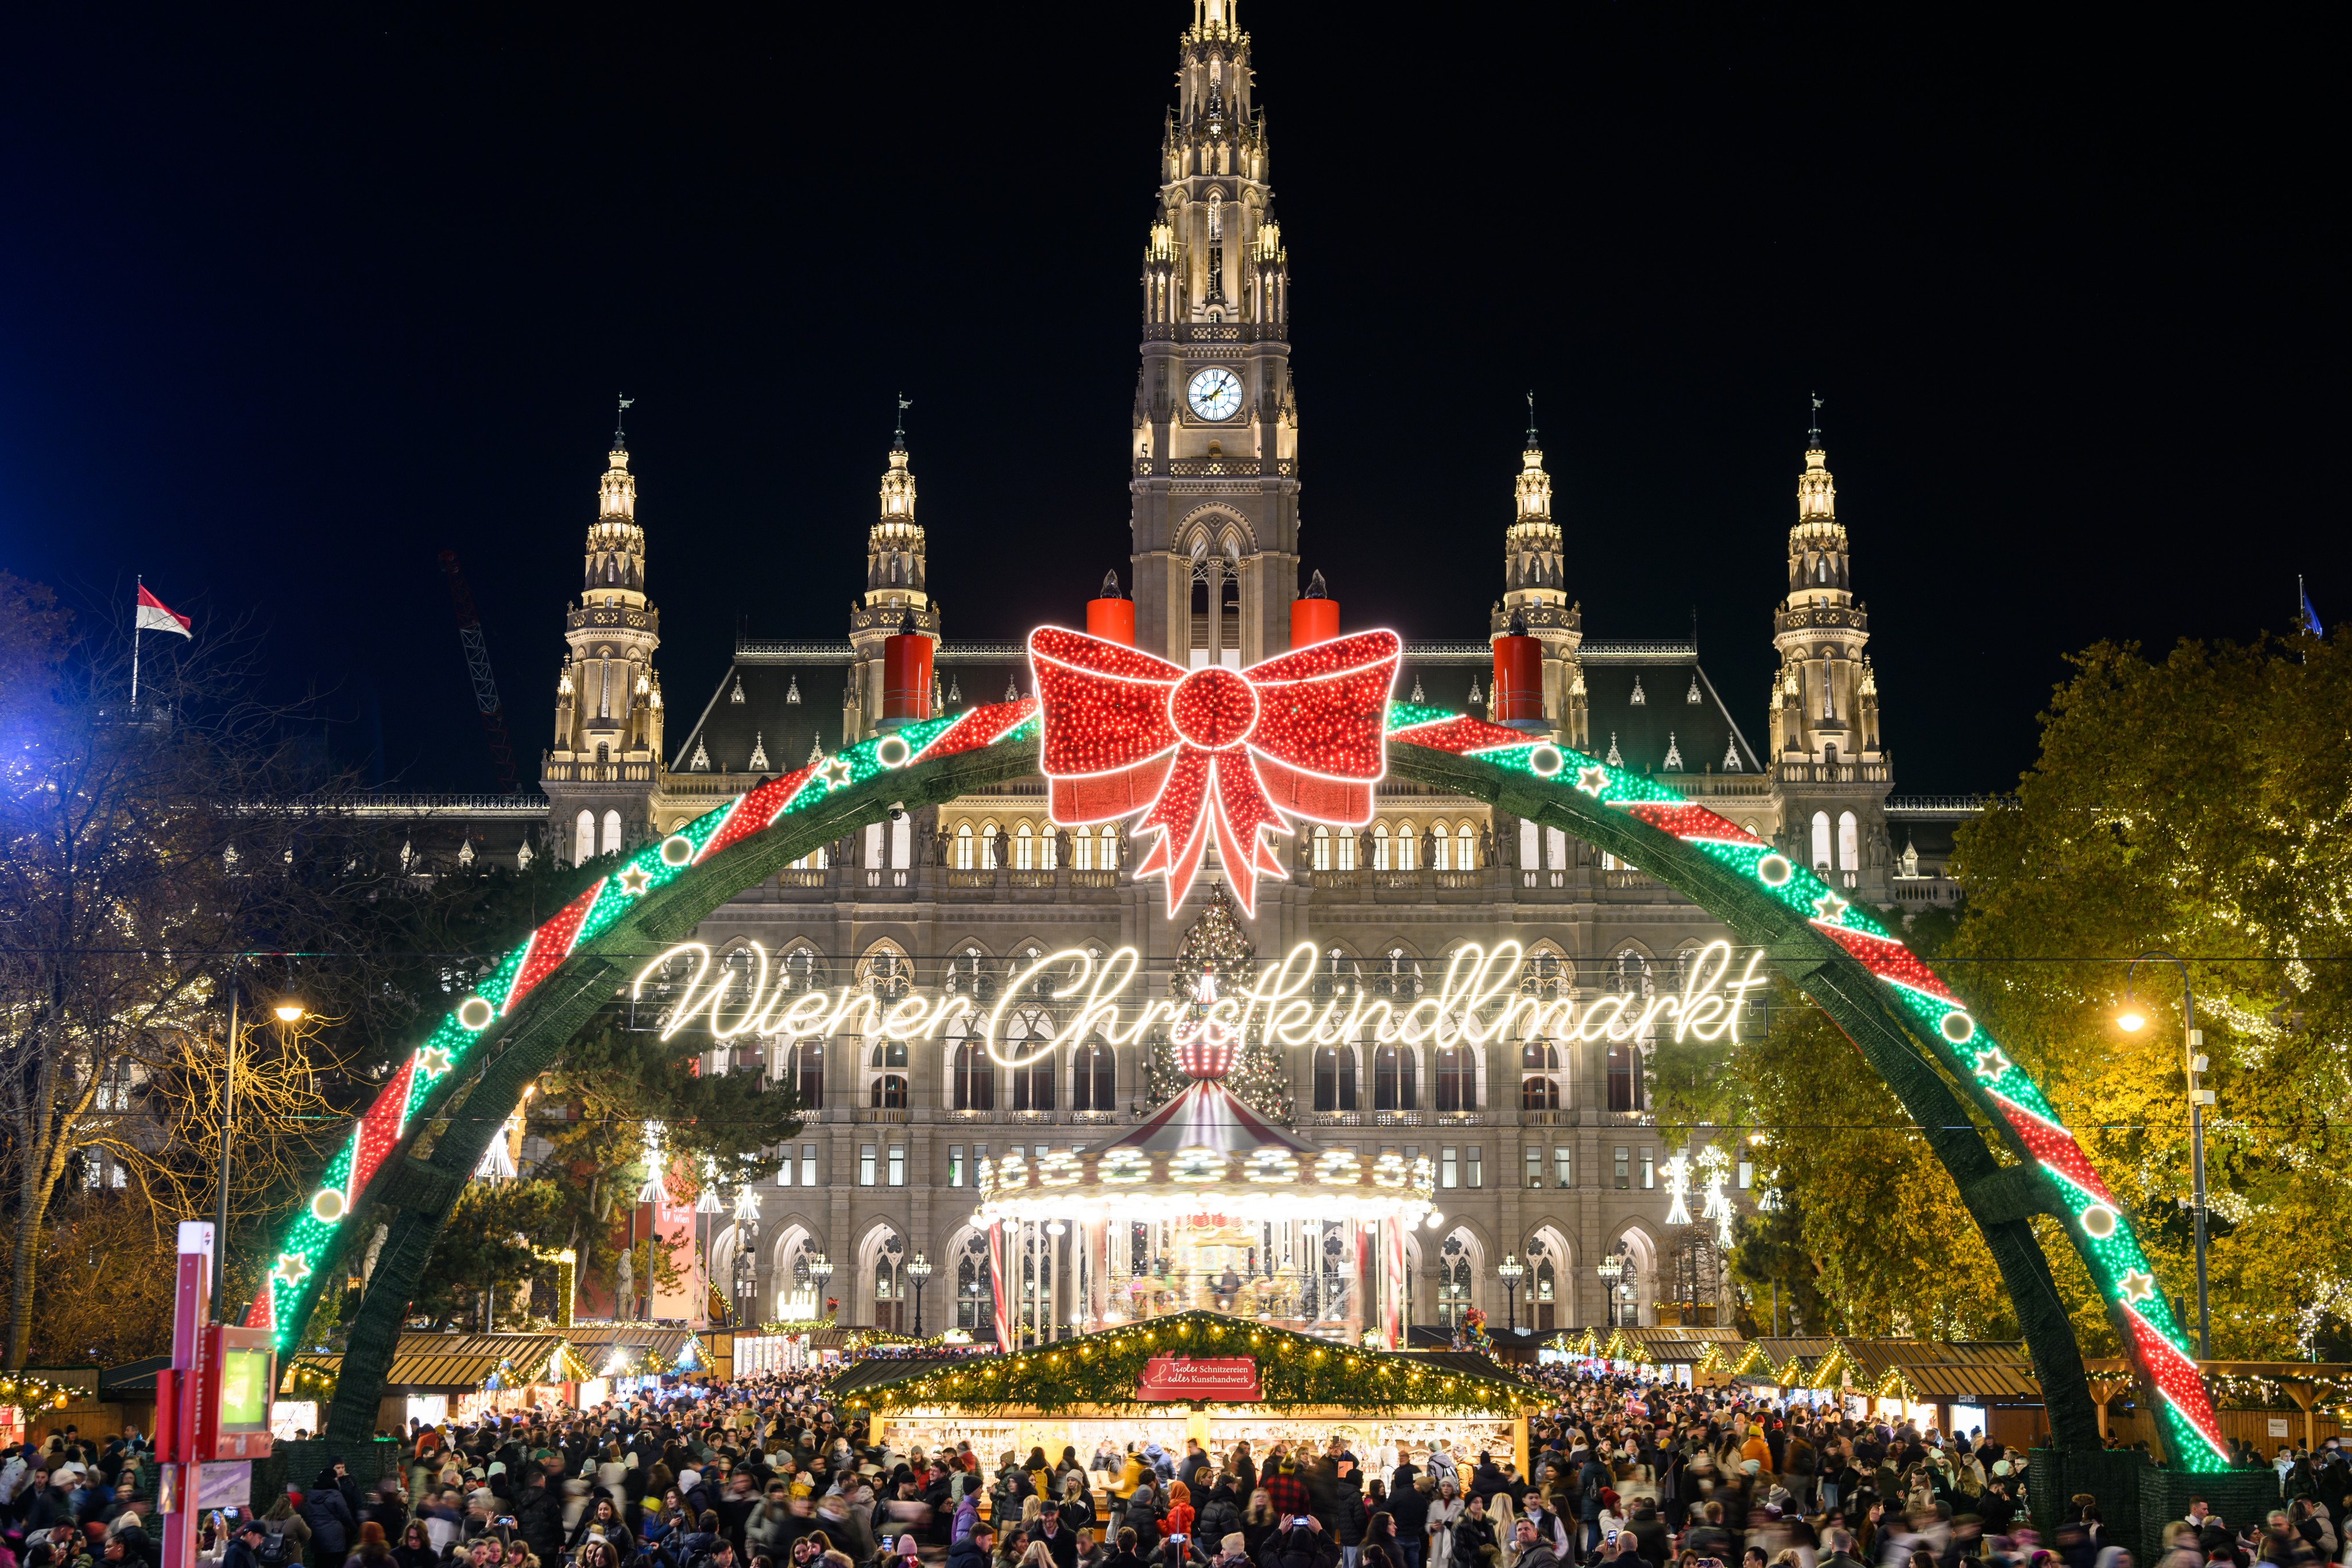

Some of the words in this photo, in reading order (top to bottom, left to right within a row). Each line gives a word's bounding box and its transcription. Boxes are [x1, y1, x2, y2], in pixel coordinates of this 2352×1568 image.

[633, 939, 971, 1042] Wiener
[987, 939, 1769, 1067] Christkindlmarkt
[674, 1204, 690, 1213] Stadt
[674, 1213, 690, 1224] Wien
[198, 1307, 207, 1373] WIENER
[1169, 1362, 1197, 1373] Tiroler
[1200, 1365, 1248, 1373] Schnitzereien
[1167, 1373, 1190, 1383] edles
[1192, 1375, 1248, 1384] Kunsthandwerk
[194, 1377, 203, 1435] LINIEN
